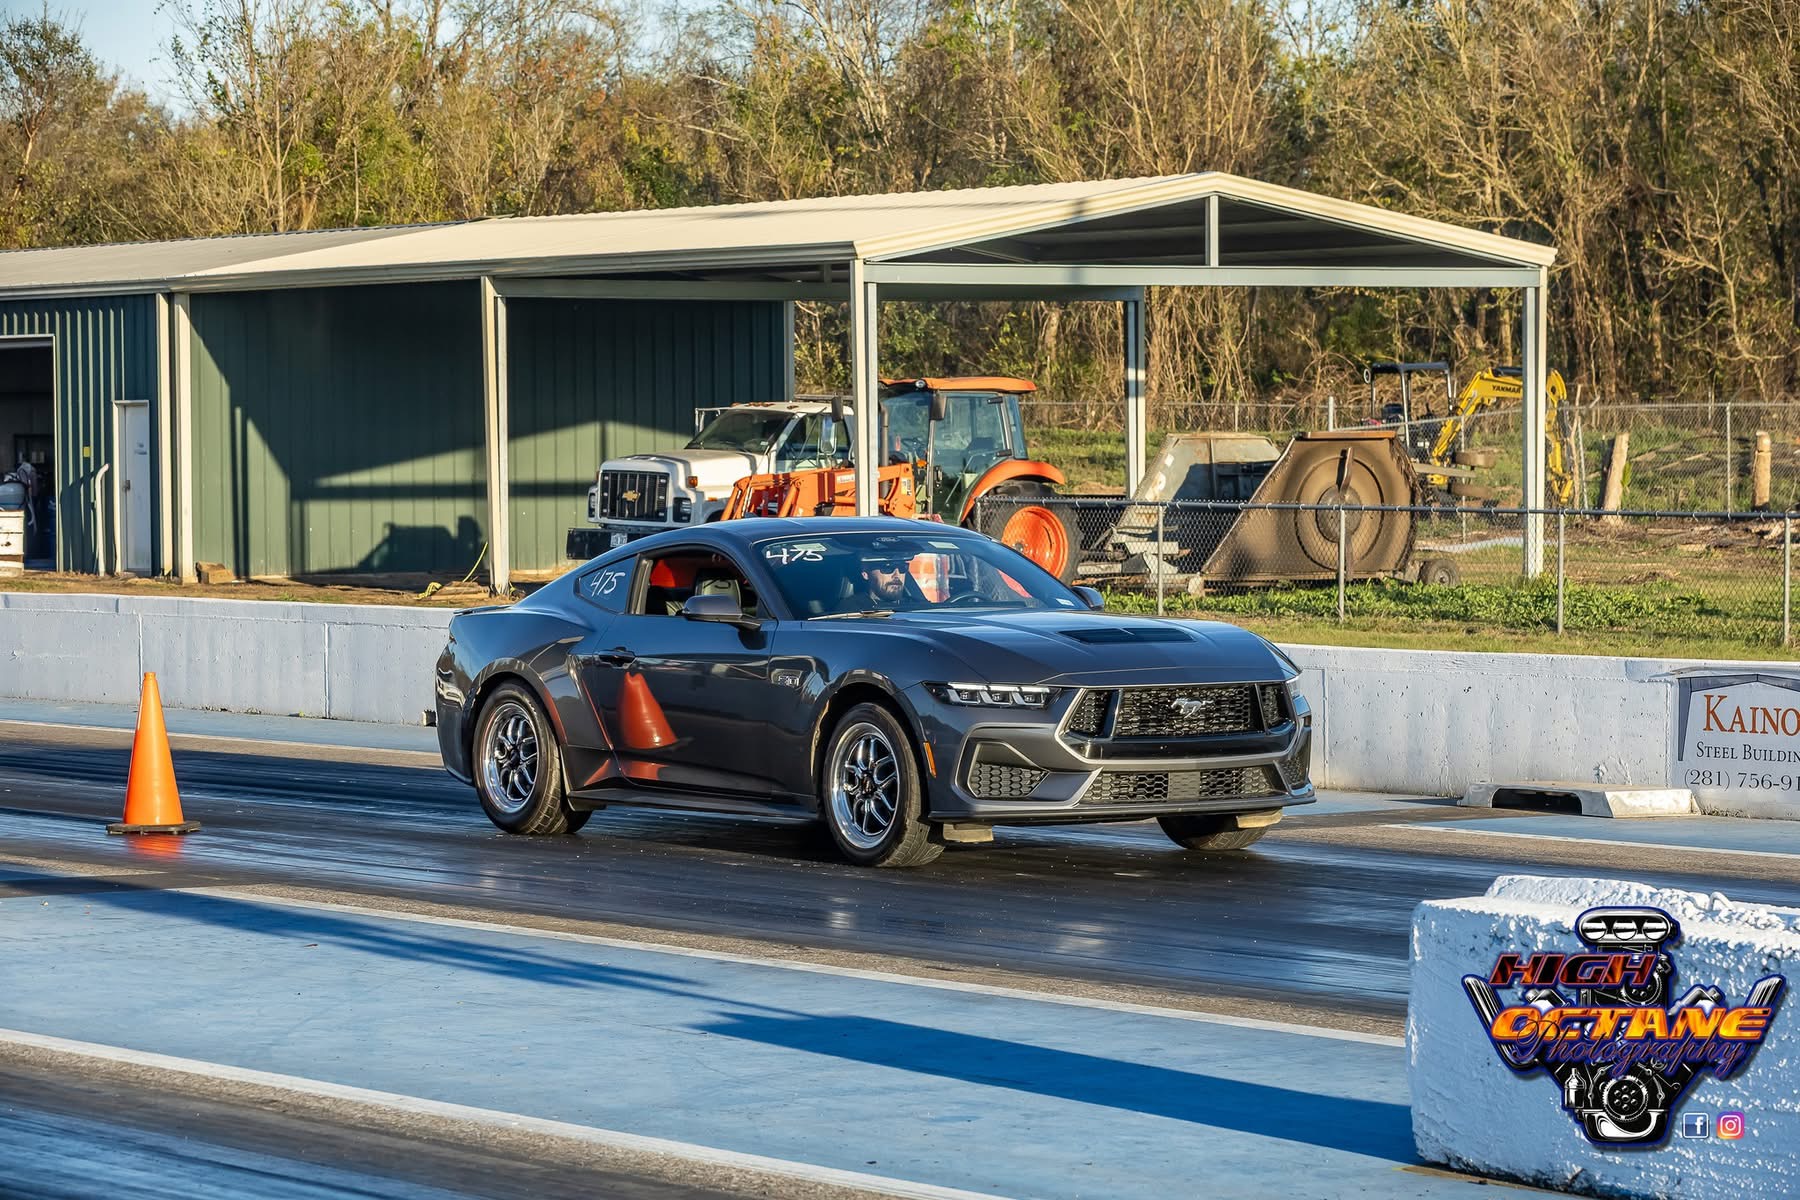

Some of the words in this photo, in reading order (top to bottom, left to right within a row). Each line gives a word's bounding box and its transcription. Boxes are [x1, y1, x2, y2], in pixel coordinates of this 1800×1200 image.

[766, 548, 826, 565] 475
[590, 569, 626, 597] 475
[1696, 741, 1738, 760] STEEL
[1684, 768, 1731, 792] (281)
